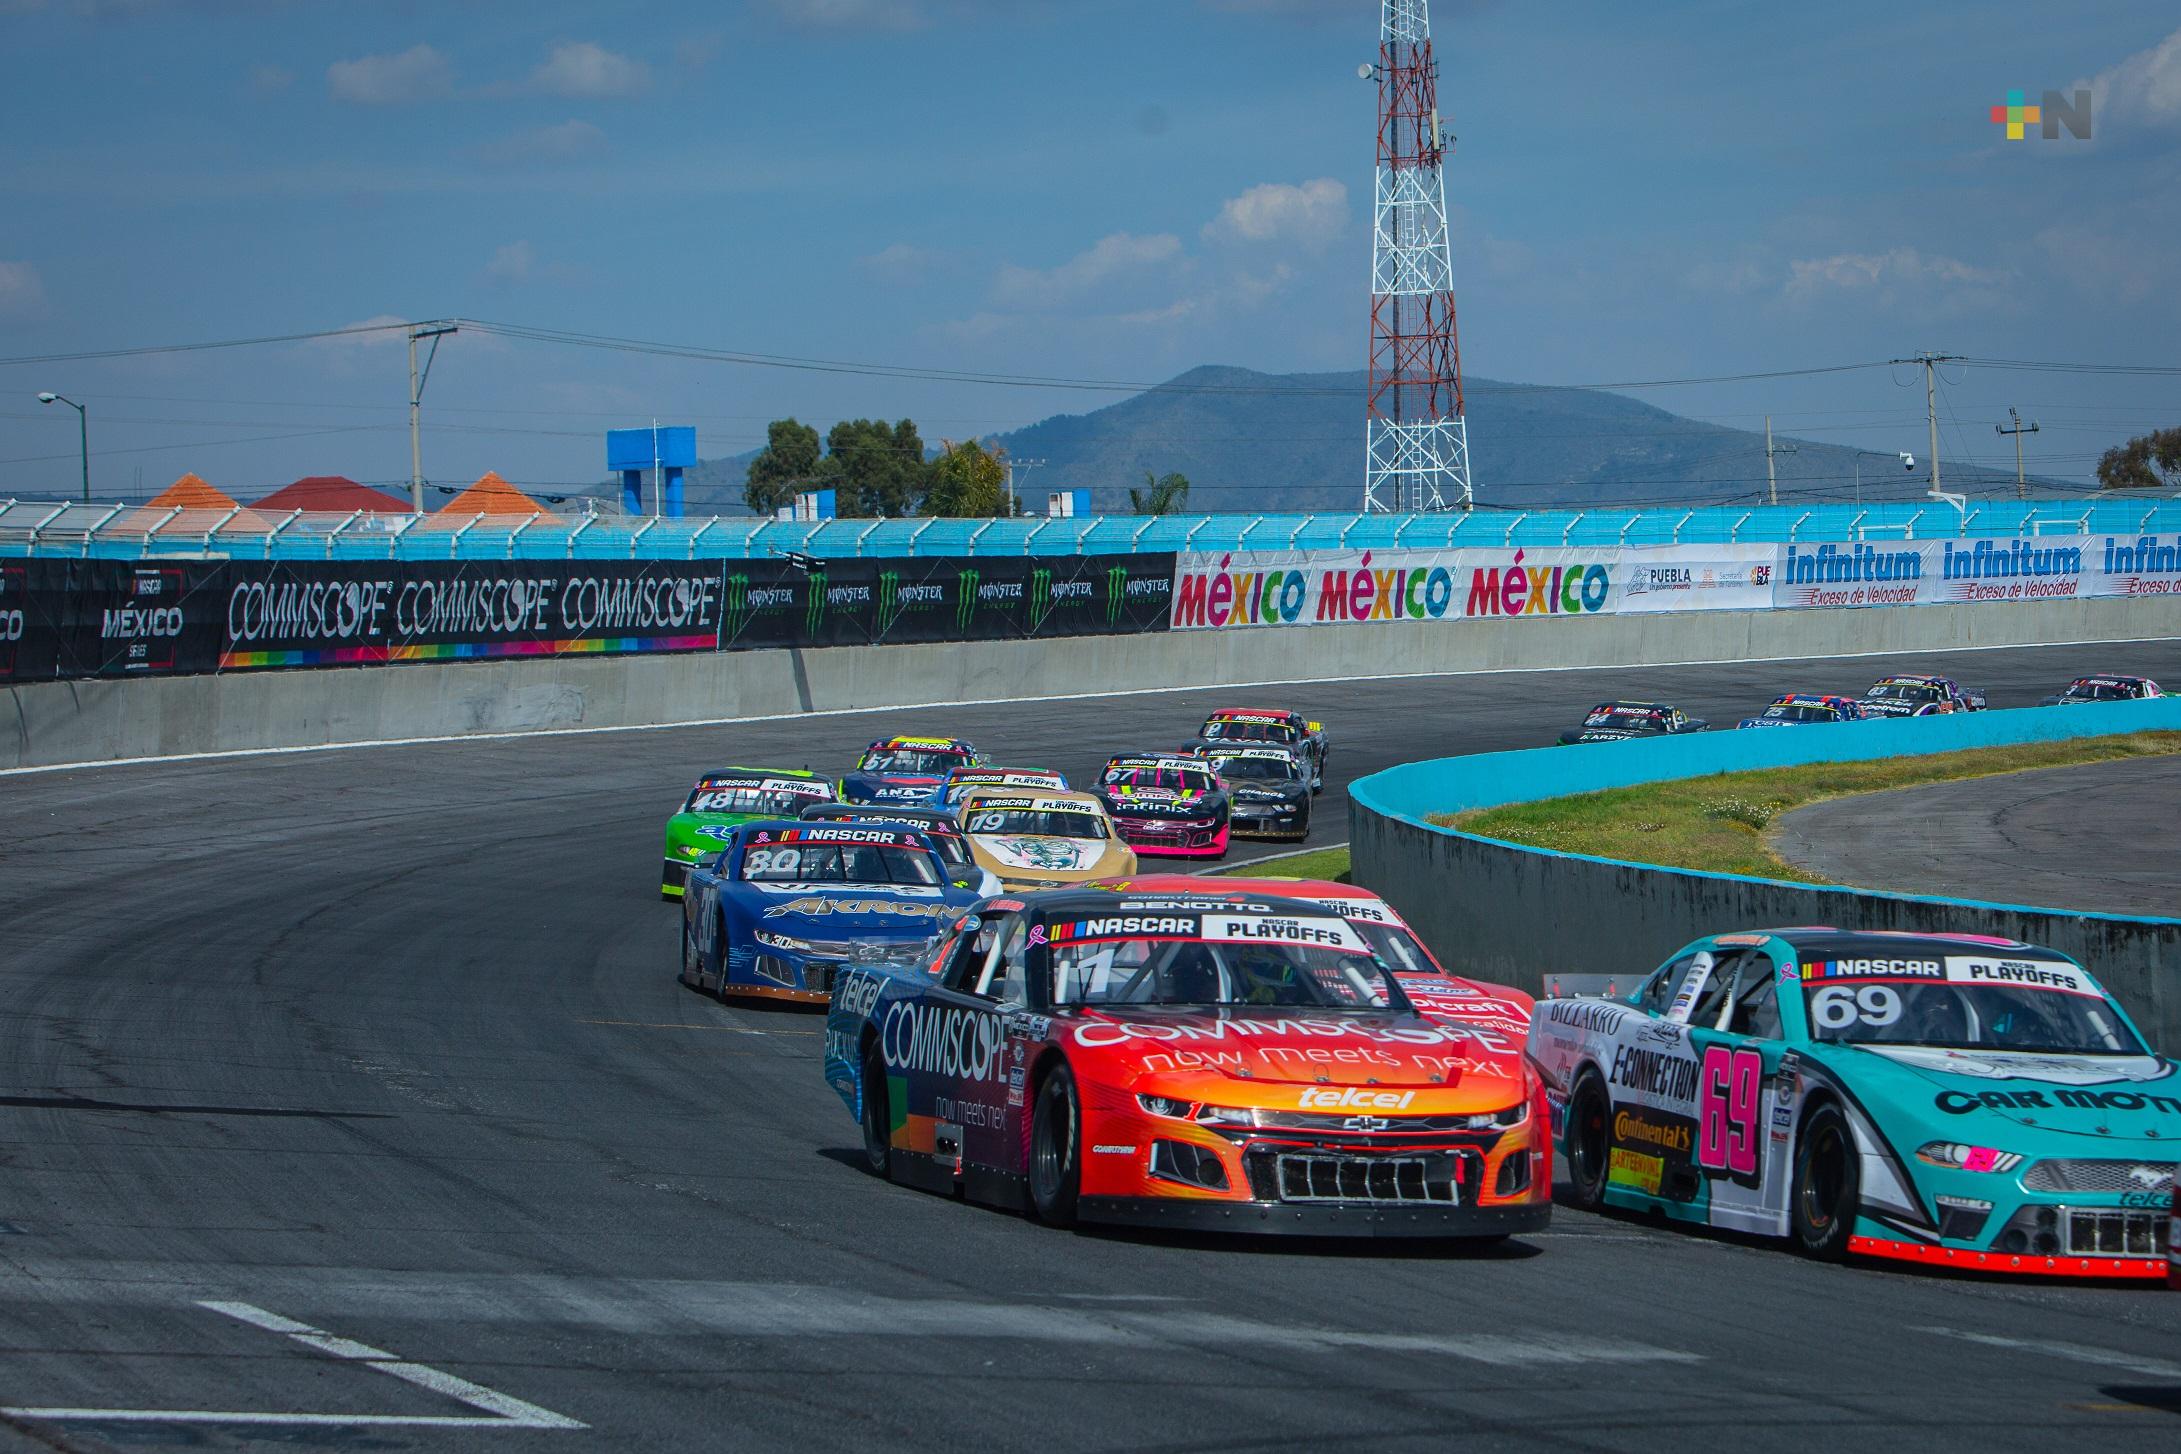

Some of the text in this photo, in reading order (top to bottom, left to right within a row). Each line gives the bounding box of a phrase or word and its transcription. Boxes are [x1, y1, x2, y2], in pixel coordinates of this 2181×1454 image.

[1786, 544, 1921, 585] infinitum
[1944, 541, 2080, 579] infinitum
[1650, 568, 1692, 583] PUEBLA
[2129, 577, 2169, 594] Exceso
[747, 587, 793, 605] MONSTER
[827, 585, 870, 605] MONSTER
[897, 583, 943, 604] MONSTER
[978, 581, 1023, 600] MONSTER
[1050, 581, 1092, 599] MONSTER
[1126, 577, 1170, 596] MONSTER
[1809, 583, 1918, 606] Exceso de Velocidad
[1967, 577, 2079, 600] Exceso de Velocidad
[228, 581, 387, 641] COMMSCOPE
[397, 578, 550, 635] COMMSCOPE
[561, 577, 715, 631] COMMSCOPE
[101, 601, 184, 639] MÉXICO
[1614, 706, 1652, 716] NASCAR
[1791, 699, 1827, 708] NASCAR
[1234, 714, 1278, 724] NASCAR
[903, 741, 953, 751] NASCAR
[1208, 749, 1286, 760] NASCAR PLAYOFFS
[863, 753, 895, 771] 51
[1121, 758, 1203, 771] NASCAR PLAYOFFS
[715, 779, 761, 788] NASCAR
[962, 774, 1004, 783] NASCAR
[1012, 777, 1057, 788] PLAYOFFS
[1104, 768, 1138, 783] 67
[771, 782, 822, 795] PLAYOFFS
[691, 792, 733, 811] 48
[985, 799, 1032, 808] NASCAR
[1042, 801, 1093, 813] PLAYOFFS
[968, 812, 1006, 833] 19
[807, 829, 896, 844] NASCAR
[746, 849, 801, 877] 30
[763, 896, 968, 919] AKRON
[1119, 901, 1272, 912] BENOTTO
[1085, 916, 1195, 936] NASCAR
[1261, 917, 1300, 927] NASCAR
[1226, 922, 1343, 946] PLAYOFFS
[1077, 948, 1115, 993] 1
[1835, 958, 1941, 978] NASCAR
[1969, 963, 2078, 991] PLAYOFFS
[840, 968, 891, 1018] telcel
[1811, 984, 1902, 1030] 69
[883, 1000, 1012, 1084] COMMSCOPE
[1074, 1019, 1519, 1055] COMMSCOPE
[1141, 1045, 1513, 1079] now meets next
[1609, 1043, 1699, 1104] E-CONNECTION
[1298, 1086, 1416, 1110] telcel
[1934, 1089, 2054, 1115] CAR
[935, 1096, 956, 1121] now
[957, 1099, 986, 1127] meets
[1183, 1101, 1204, 1122] 1
[1699, 1045, 1762, 1177] 69
[1615, 1110, 1680, 1150] Continental
[2119, 1191, 2174, 1207] telce
